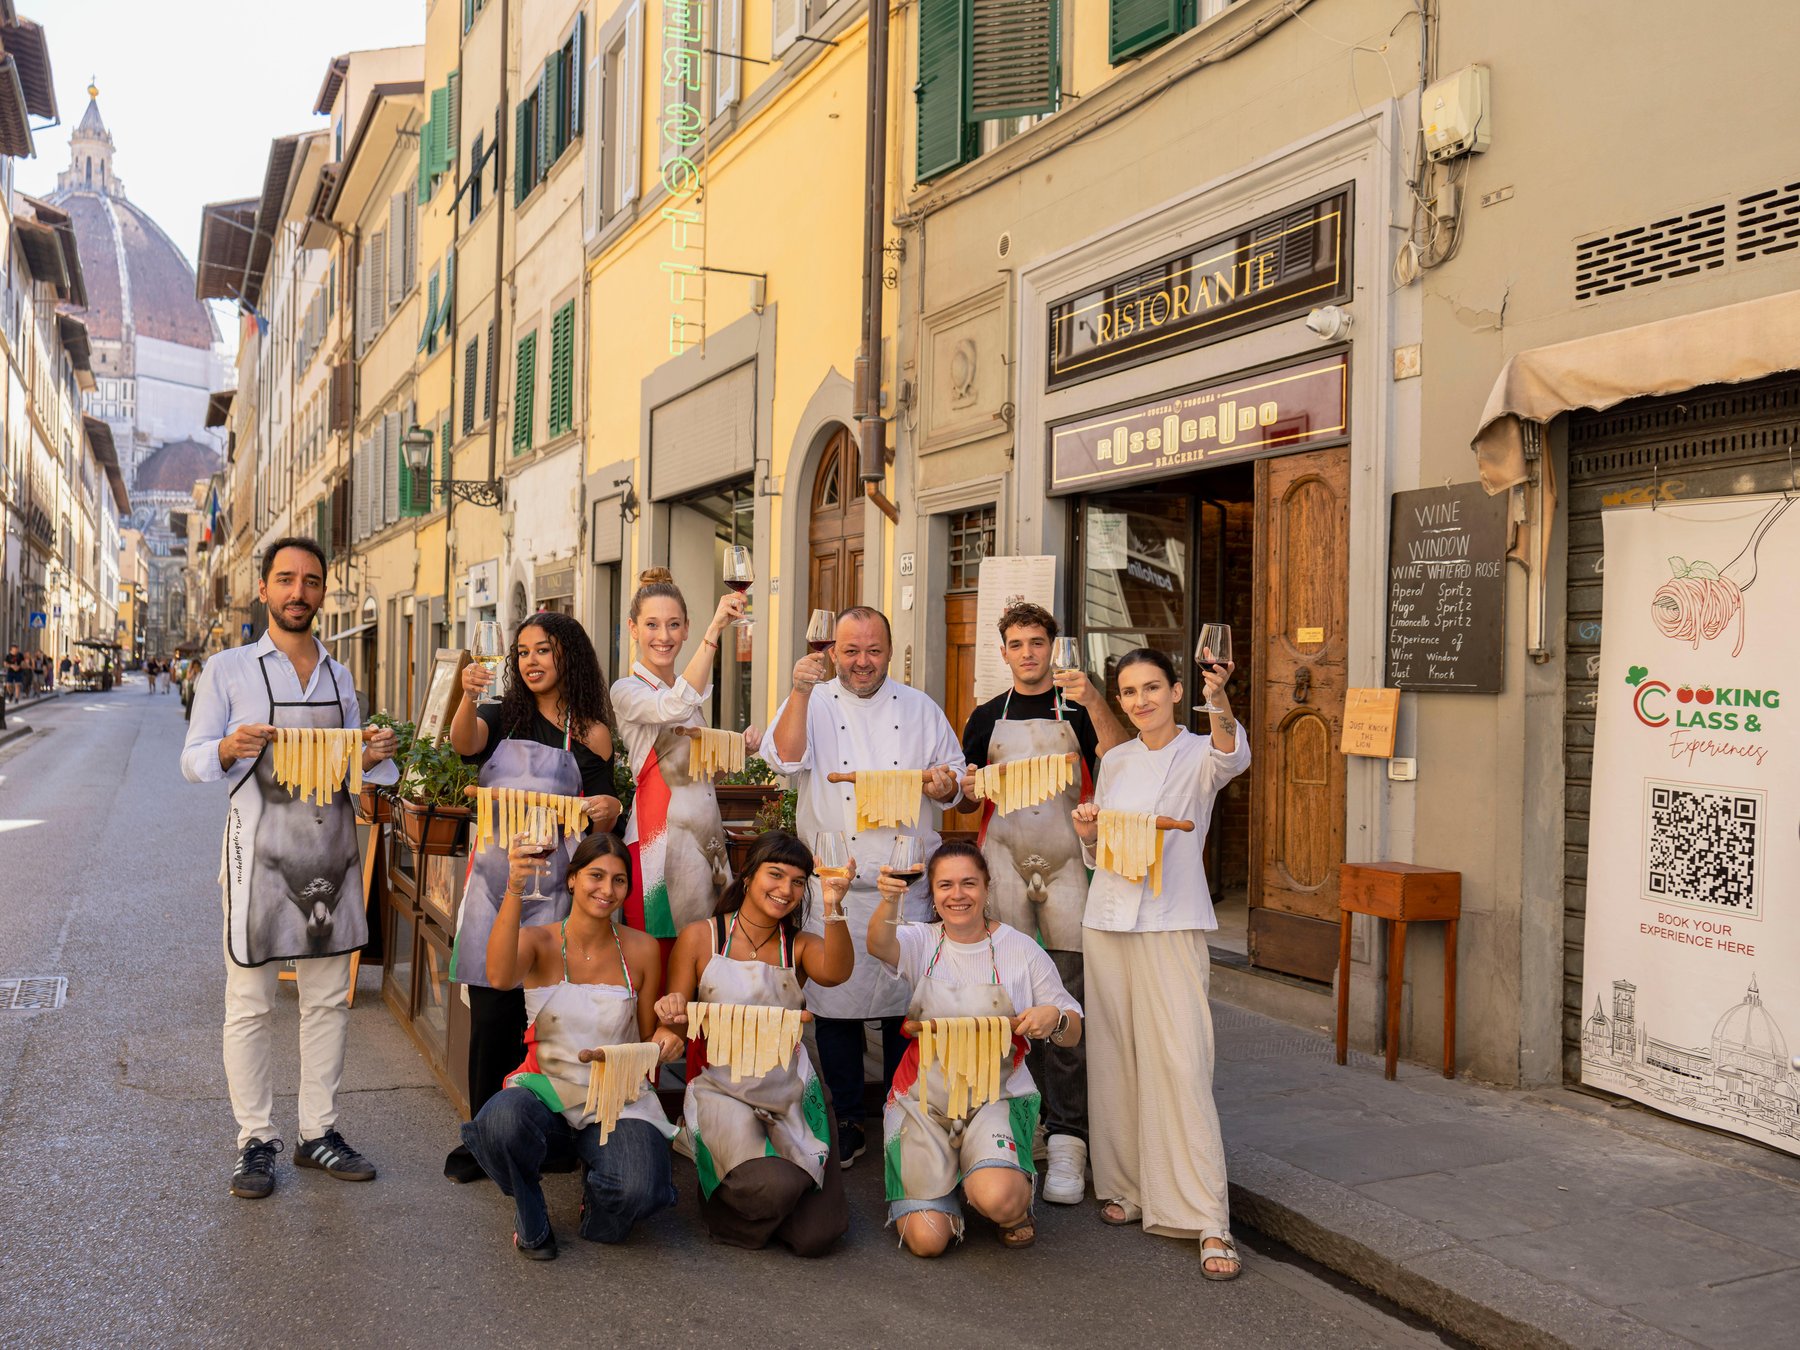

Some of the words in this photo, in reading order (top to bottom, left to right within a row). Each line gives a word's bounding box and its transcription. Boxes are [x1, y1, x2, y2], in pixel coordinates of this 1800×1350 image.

[1096, 252, 1275, 346] RISTORANTE
[1183, 393, 1215, 408] TOSCANA
[1155, 449, 1204, 468] BRACERIE
[1414, 501, 1461, 528] WINE
[1408, 534, 1470, 561] WINDOW
[1391, 564, 1424, 580] WINE
[1391, 582, 1425, 602] Aperol
[1391, 600, 1415, 619] Hugo
[1390, 614, 1430, 628] Limoncello
[1390, 629, 1440, 649] Experience
[1391, 648, 1413, 660] Wine
[1391, 662, 1411, 678] Just
[1428, 664, 1455, 679] Knock
[1744, 713, 1762, 733] &
[1658, 912, 1690, 929] BOOK
[1693, 919, 1732, 937] YOUR
[1640, 923, 1713, 949] EXPERIENCE
[1717, 939, 1755, 957] HERE
